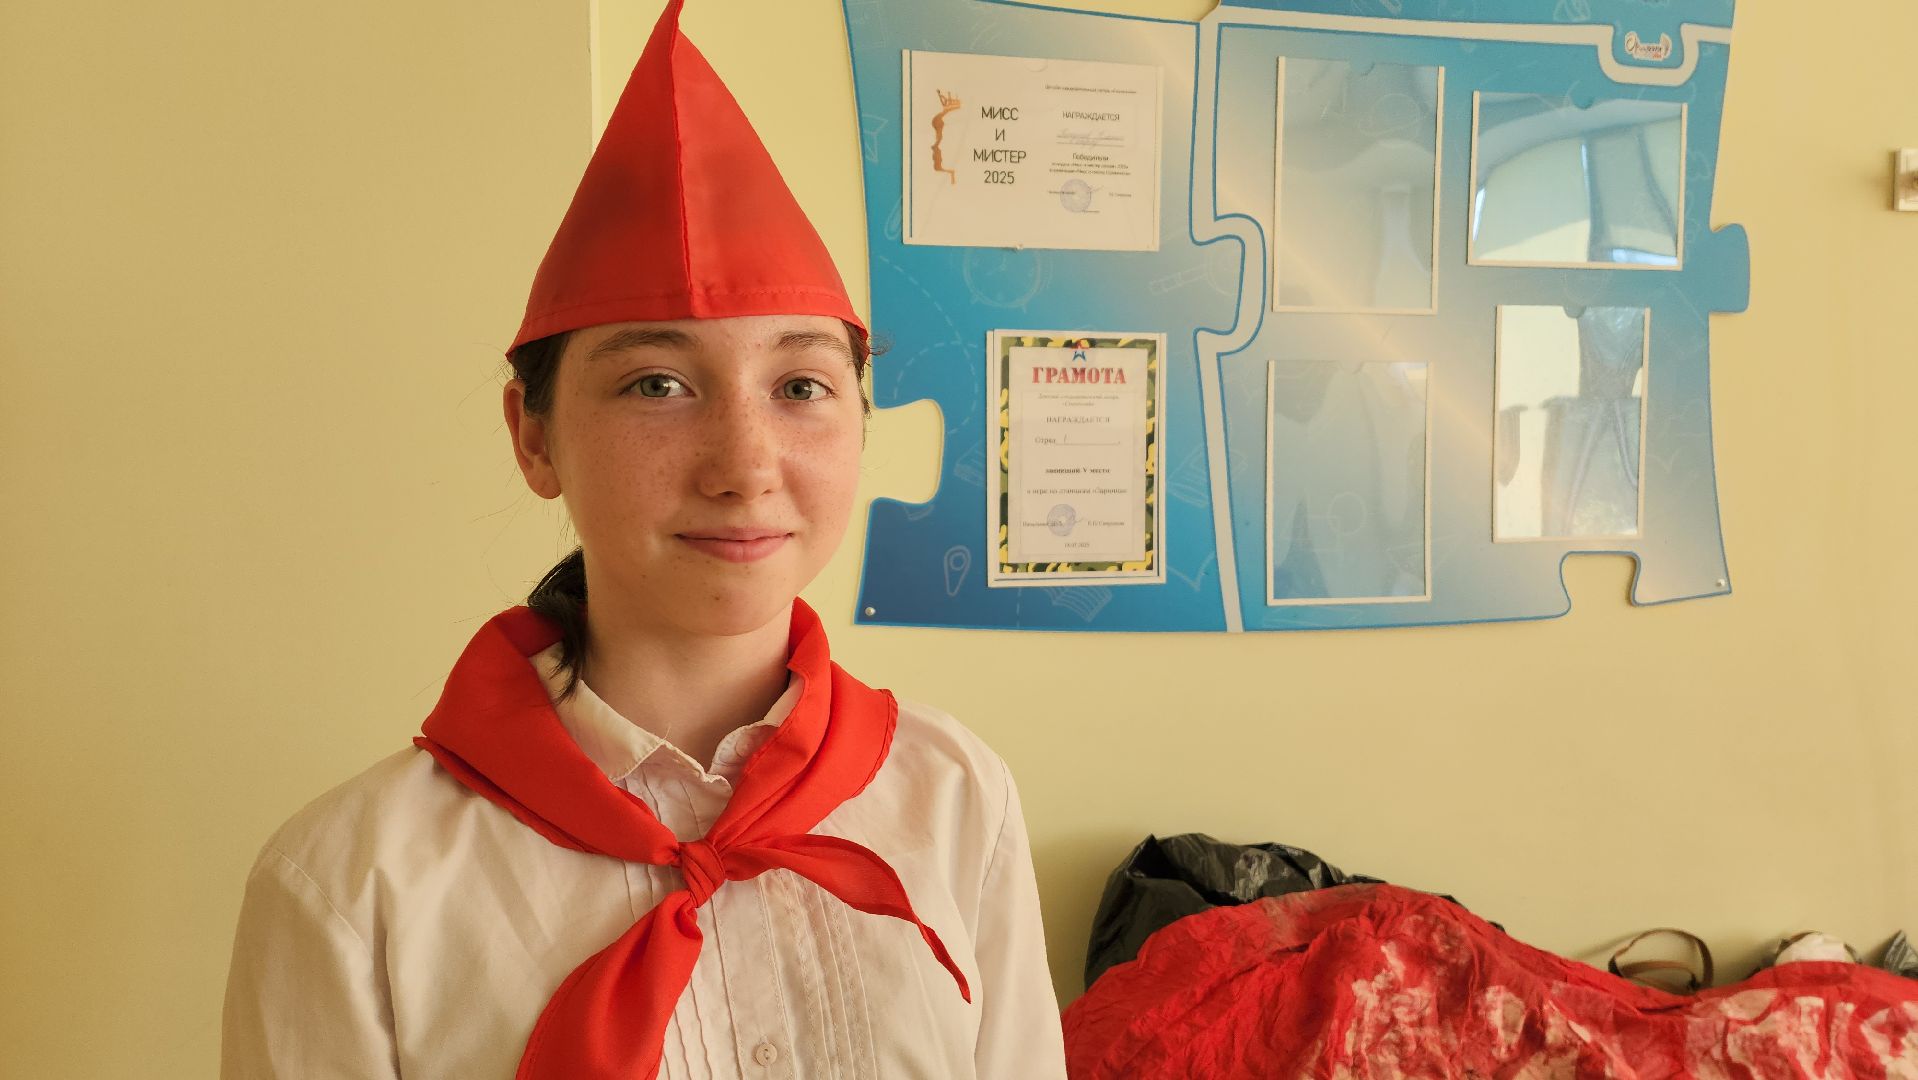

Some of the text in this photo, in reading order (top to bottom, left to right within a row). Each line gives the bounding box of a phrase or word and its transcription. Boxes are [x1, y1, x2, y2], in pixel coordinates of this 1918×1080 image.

[981, 105, 1019, 121] МИСС
[1062, 110, 1120, 121] НАГРАЖДАЕТСЯ
[994, 127, 1006, 142] И
[973, 147, 1027, 164] МИСТЕР
[983, 170, 1015, 184] 2025
[1031, 366, 1127, 385] ГРАМОТА
